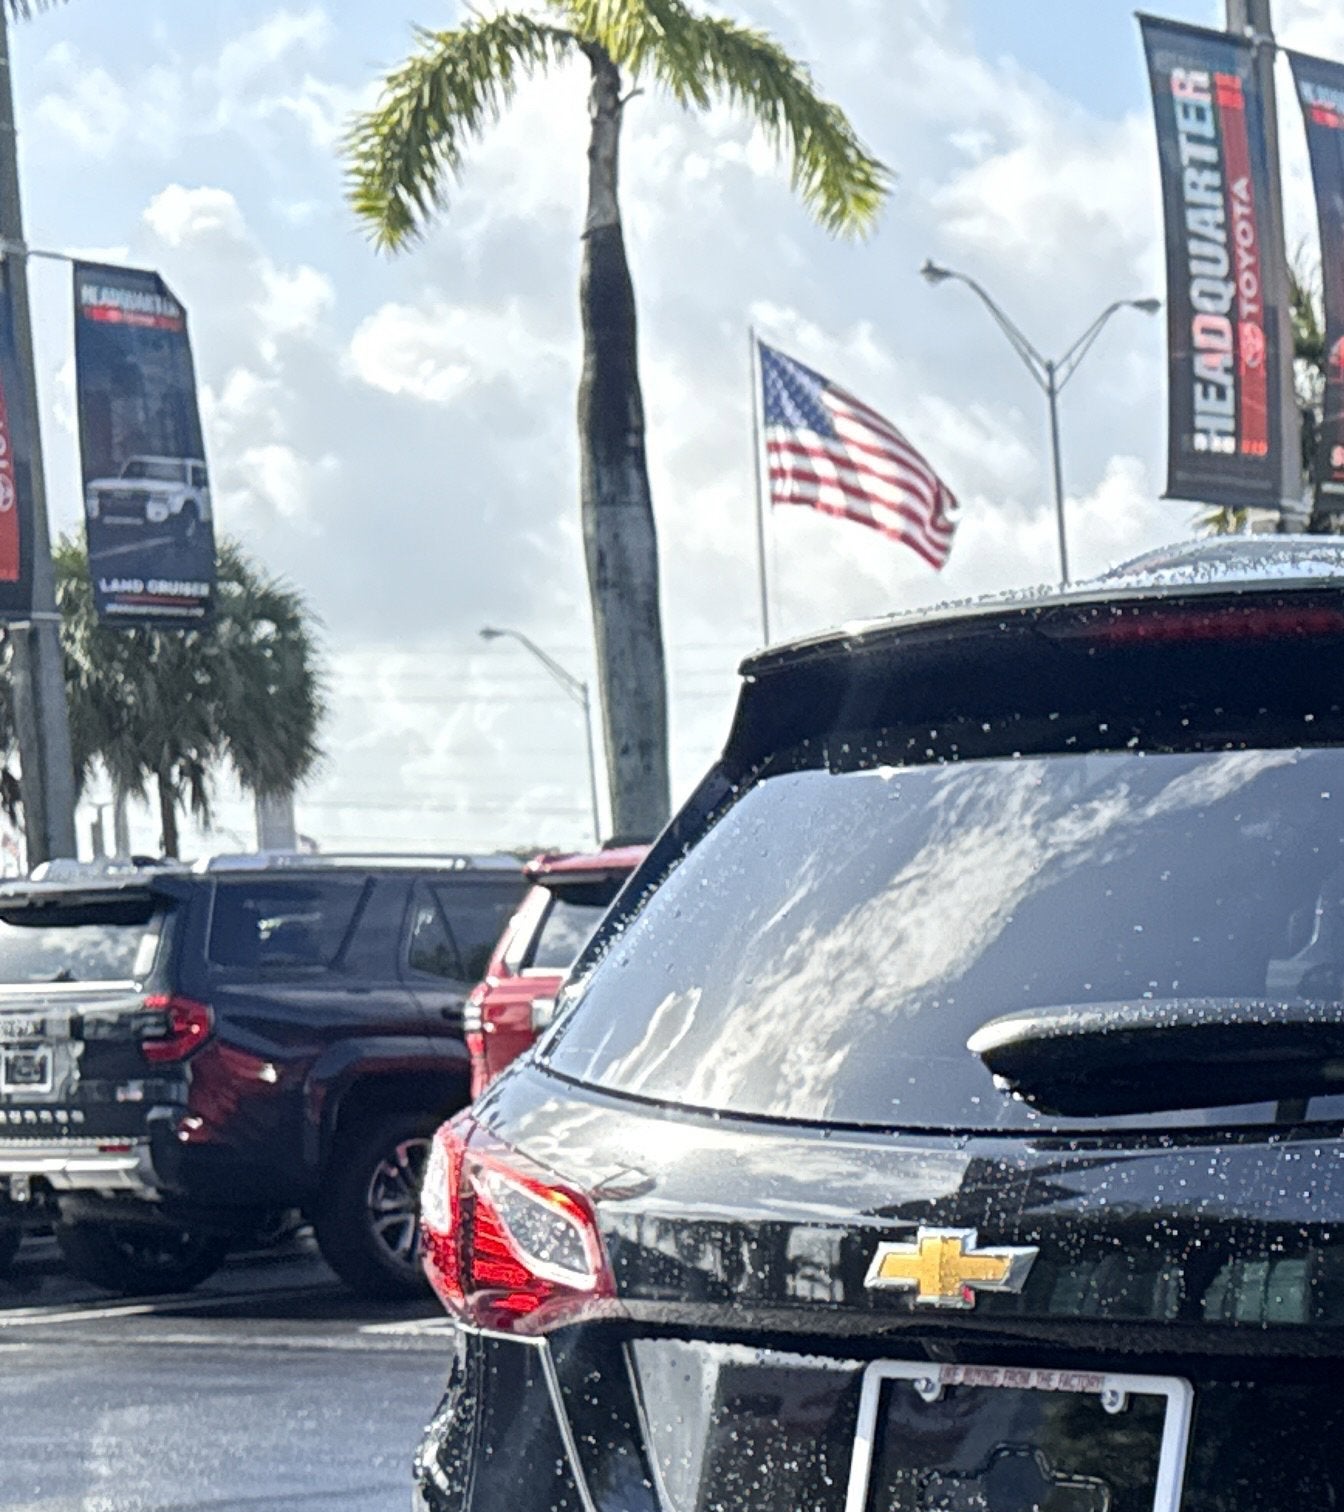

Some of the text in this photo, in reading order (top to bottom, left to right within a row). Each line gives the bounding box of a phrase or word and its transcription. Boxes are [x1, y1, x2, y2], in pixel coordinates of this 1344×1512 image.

[1170, 67, 1236, 455] HEADQUARTER
[1230, 176, 1264, 320] TOYOTA
[99, 578, 145, 594] LAND
